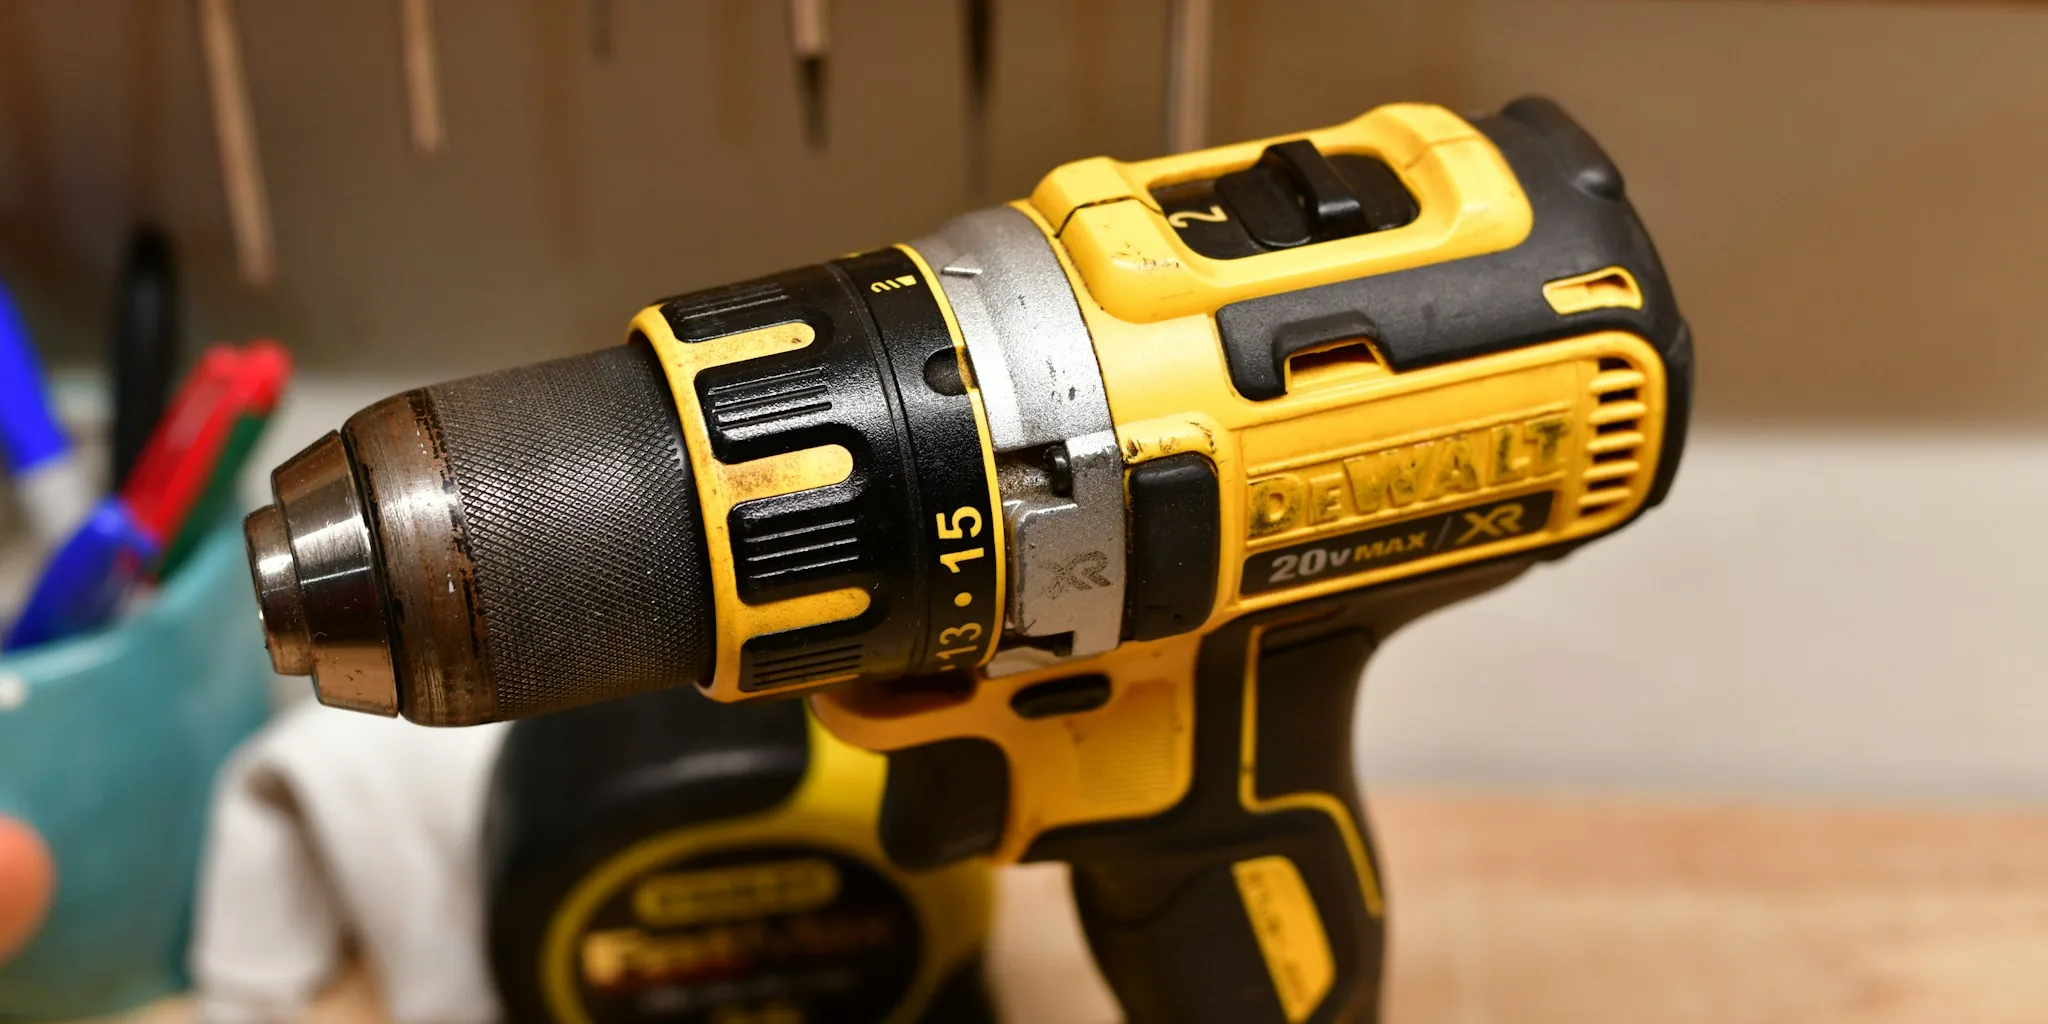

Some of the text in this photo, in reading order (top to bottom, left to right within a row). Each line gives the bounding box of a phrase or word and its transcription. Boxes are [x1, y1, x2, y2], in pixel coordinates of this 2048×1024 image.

[1168, 205, 1228, 228] 2
[1455, 504, 1525, 546] XR
[936, 506, 984, 663] 13 15
